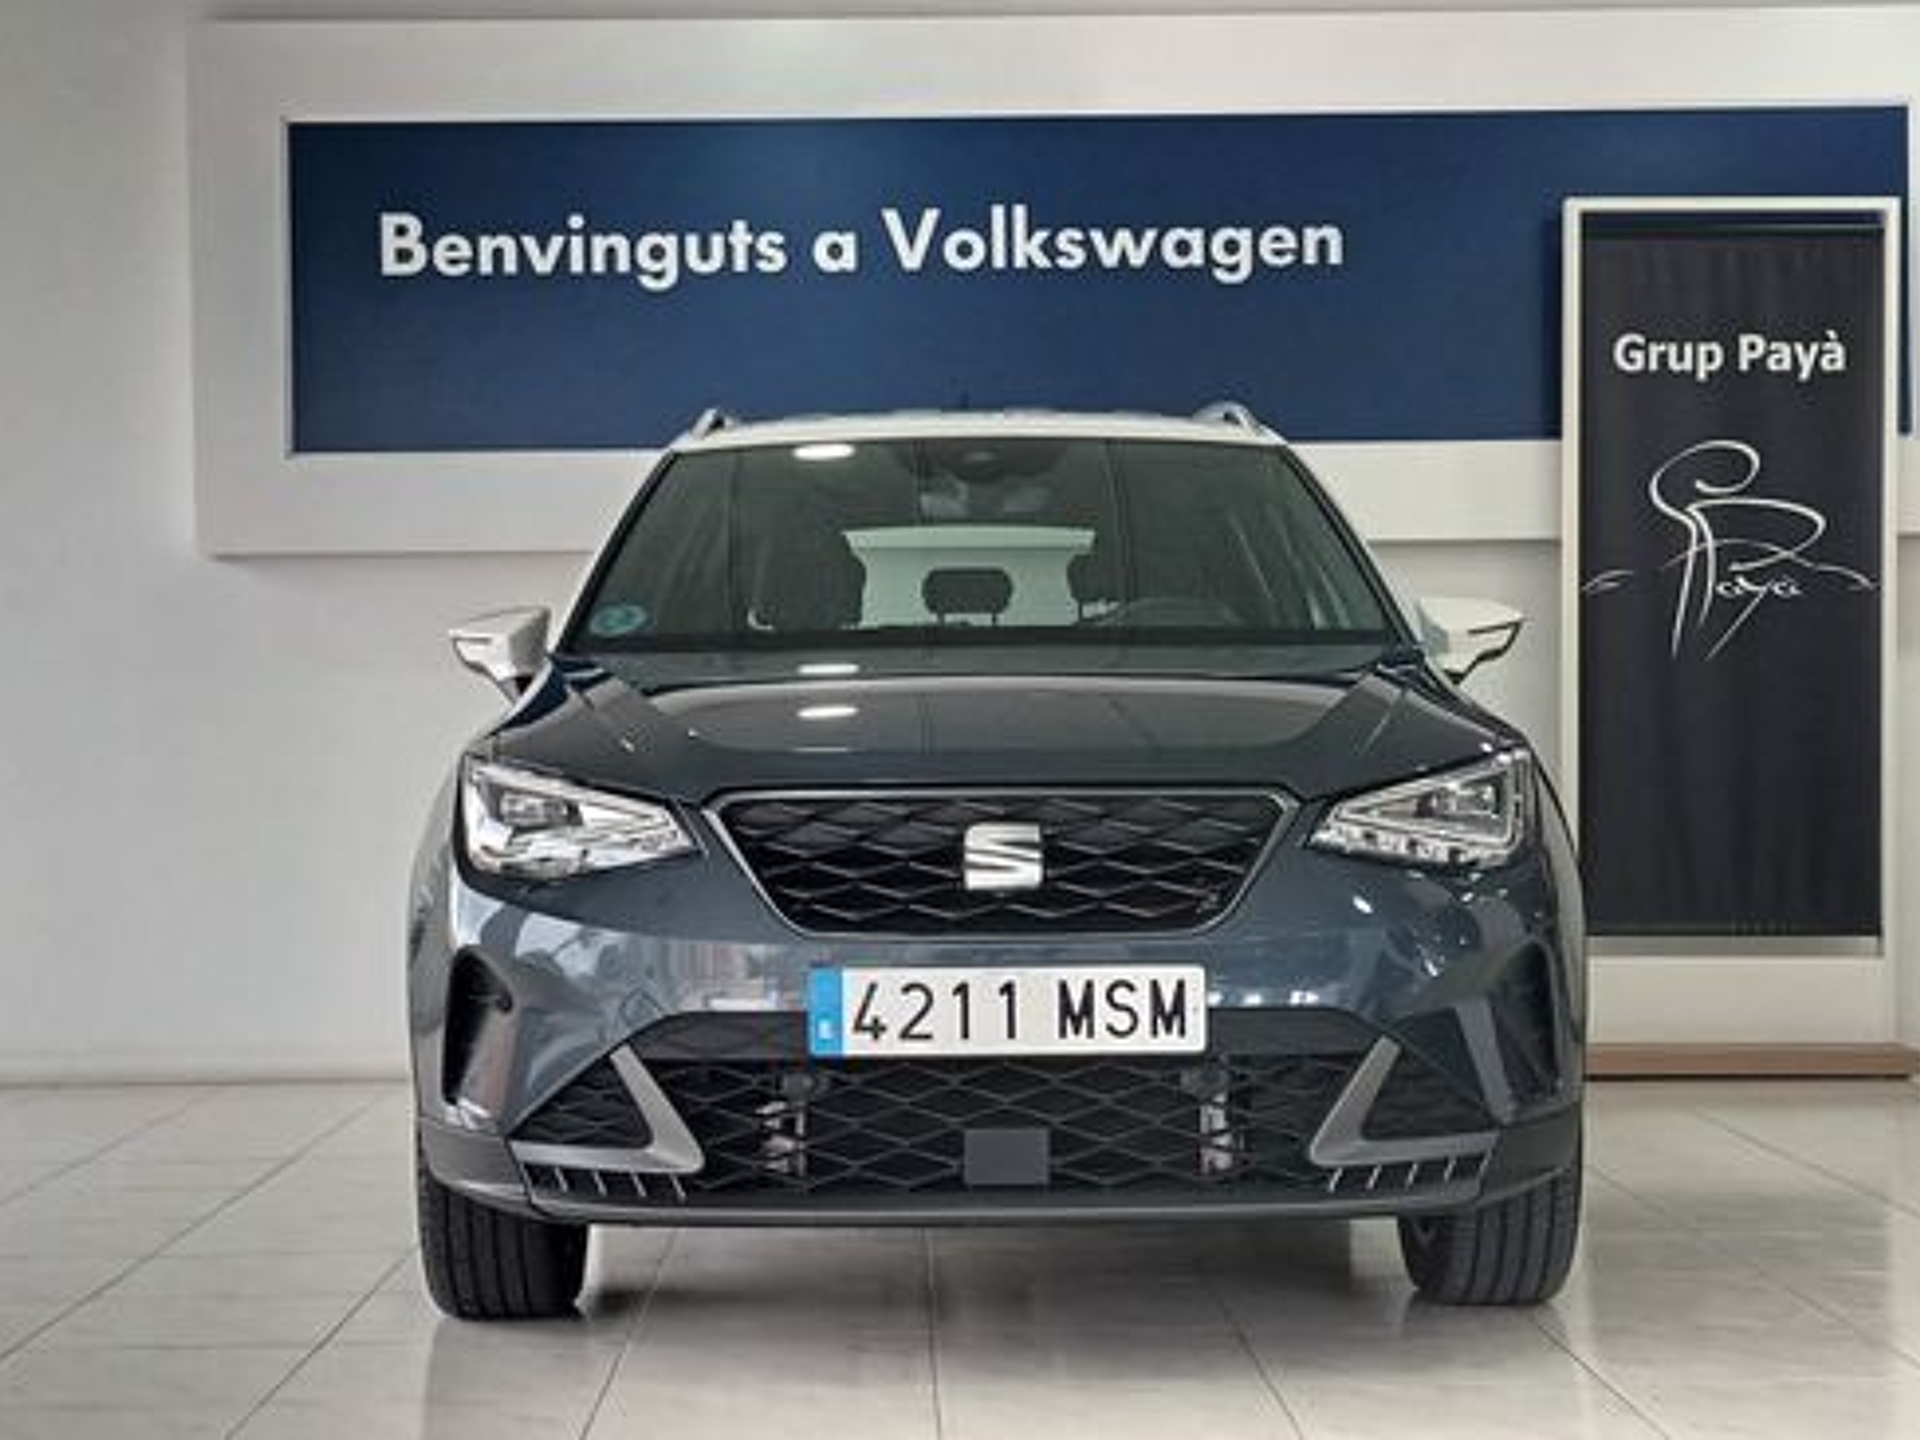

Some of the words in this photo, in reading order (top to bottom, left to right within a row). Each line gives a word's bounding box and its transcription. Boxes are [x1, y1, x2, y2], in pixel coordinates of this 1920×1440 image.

[380, 213, 788, 291] Benvinguts
[812, 231, 857, 274] a
[882, 204, 1344, 284] Volkswagen
[1613, 333, 1724, 382] Grup
[1738, 330, 1847, 382] Payà
[853, 981, 1017, 1041] 4211
[1058, 979, 1187, 1040] MSM
